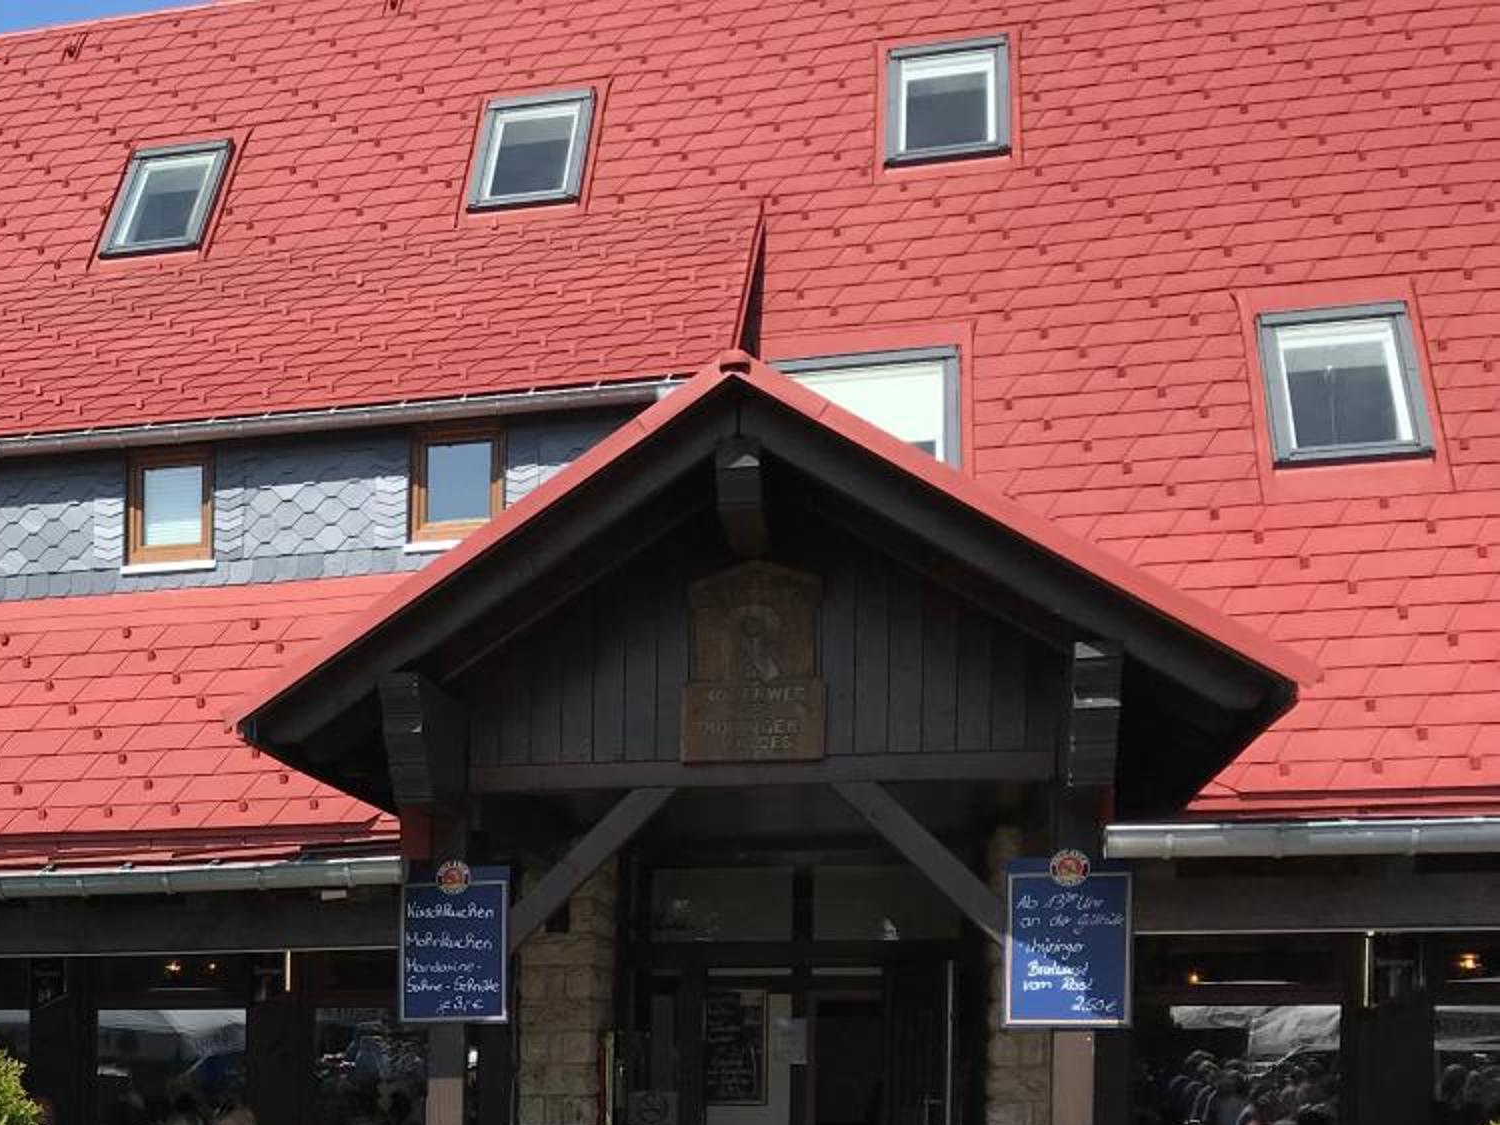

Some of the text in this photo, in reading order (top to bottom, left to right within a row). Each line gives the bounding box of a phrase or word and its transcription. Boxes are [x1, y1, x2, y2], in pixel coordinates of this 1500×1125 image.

[407, 902, 495, 920] Kirschkuchen
[1016, 895, 1039, 910] Ab
[1076, 894, 1105, 911] Uhr
[1020, 916, 1041, 929] an
[1049, 913, 1073, 927] der
[1027, 959, 1089, 977] Bratwurst
[1023, 977, 1093, 992] vom Rost
